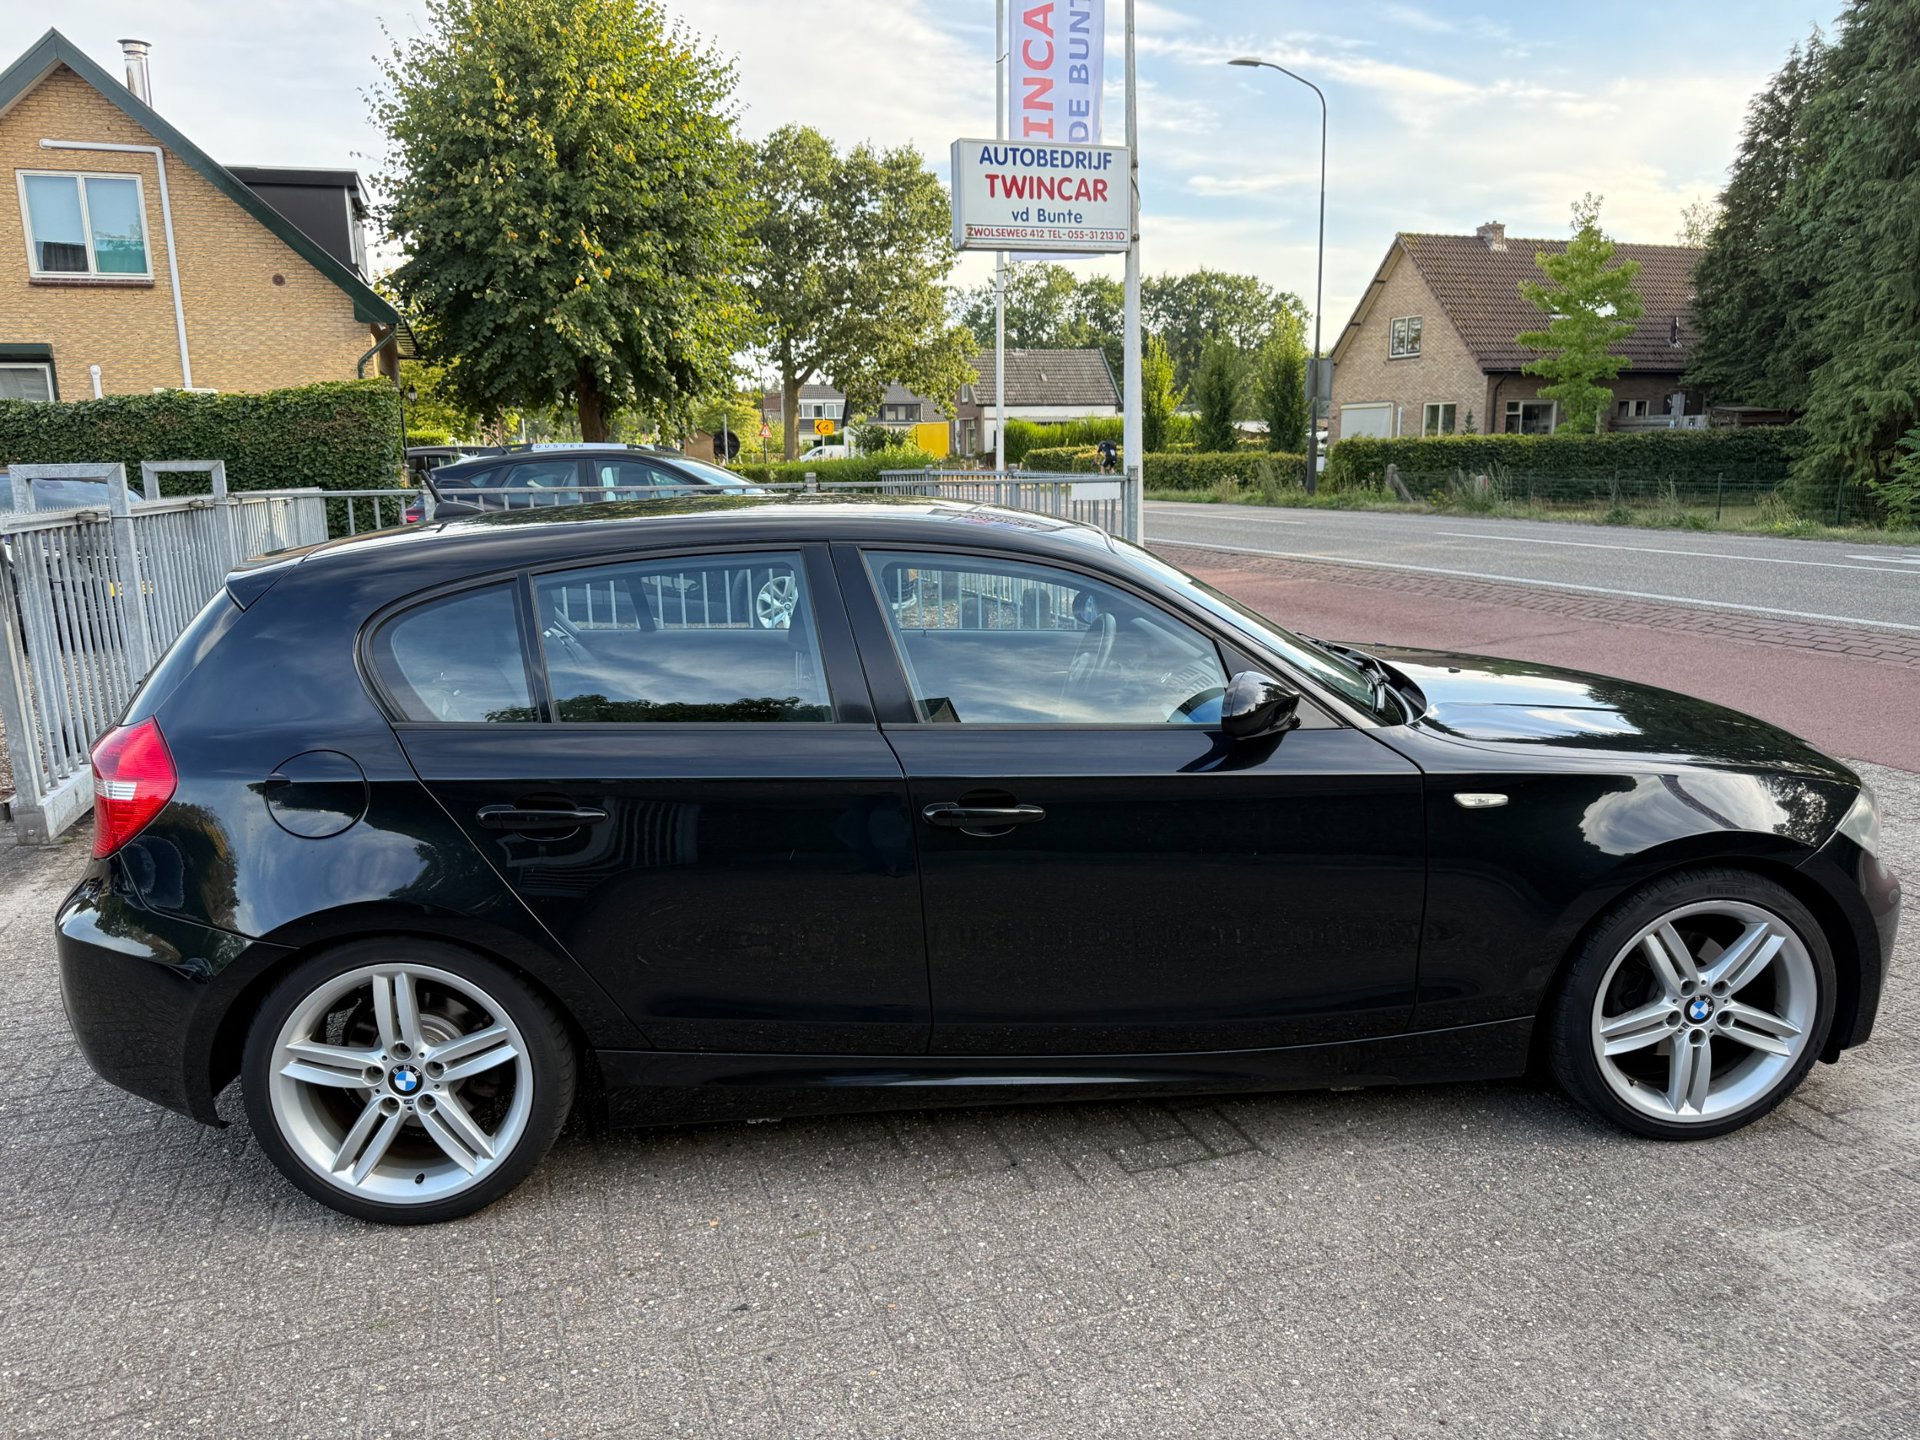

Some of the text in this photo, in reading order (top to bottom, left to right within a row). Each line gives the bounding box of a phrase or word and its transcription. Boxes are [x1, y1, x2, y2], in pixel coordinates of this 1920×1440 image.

[1068, 99, 1090, 142] DE
[979, 146, 1112, 170] AUTOBEDRIJF
[985, 174, 1108, 202] TWINCAR
[1011, 207, 1083, 224] vd Bunte
[967, 226, 1027, 238] ZWOLSEWEG
[1029, 228, 1045, 239] 412
[392, 1064, 421, 1077] BMW
